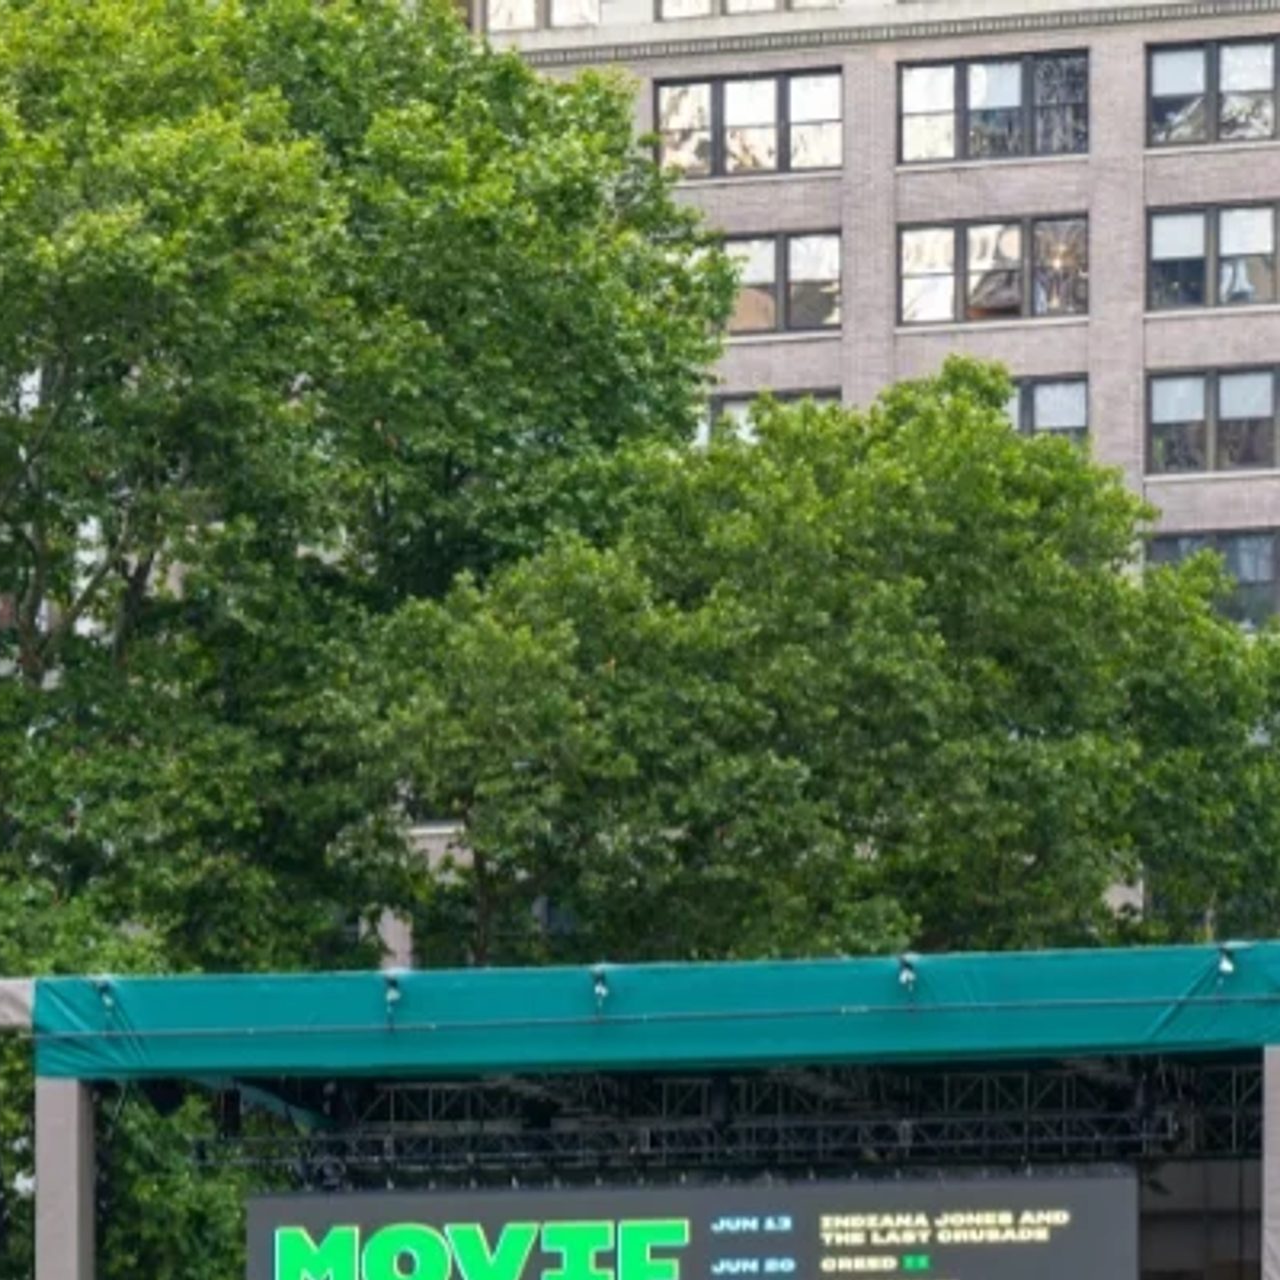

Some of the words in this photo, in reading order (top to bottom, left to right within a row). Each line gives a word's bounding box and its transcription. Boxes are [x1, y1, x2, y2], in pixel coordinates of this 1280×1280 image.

[711, 1216, 759, 1232] JUN
[821, 1213, 929, 1228] INDIANA
[933, 1211, 1013, 1227] JONES
[1018, 1210, 1070, 1225] AND
[821, 1230, 866, 1247] THE
[869, 1229, 933, 1245] LAST
[936, 1227, 1051, 1244] CRUSADE
[711, 1258, 759, 1274] JUN
[821, 1257, 898, 1272] CREED
